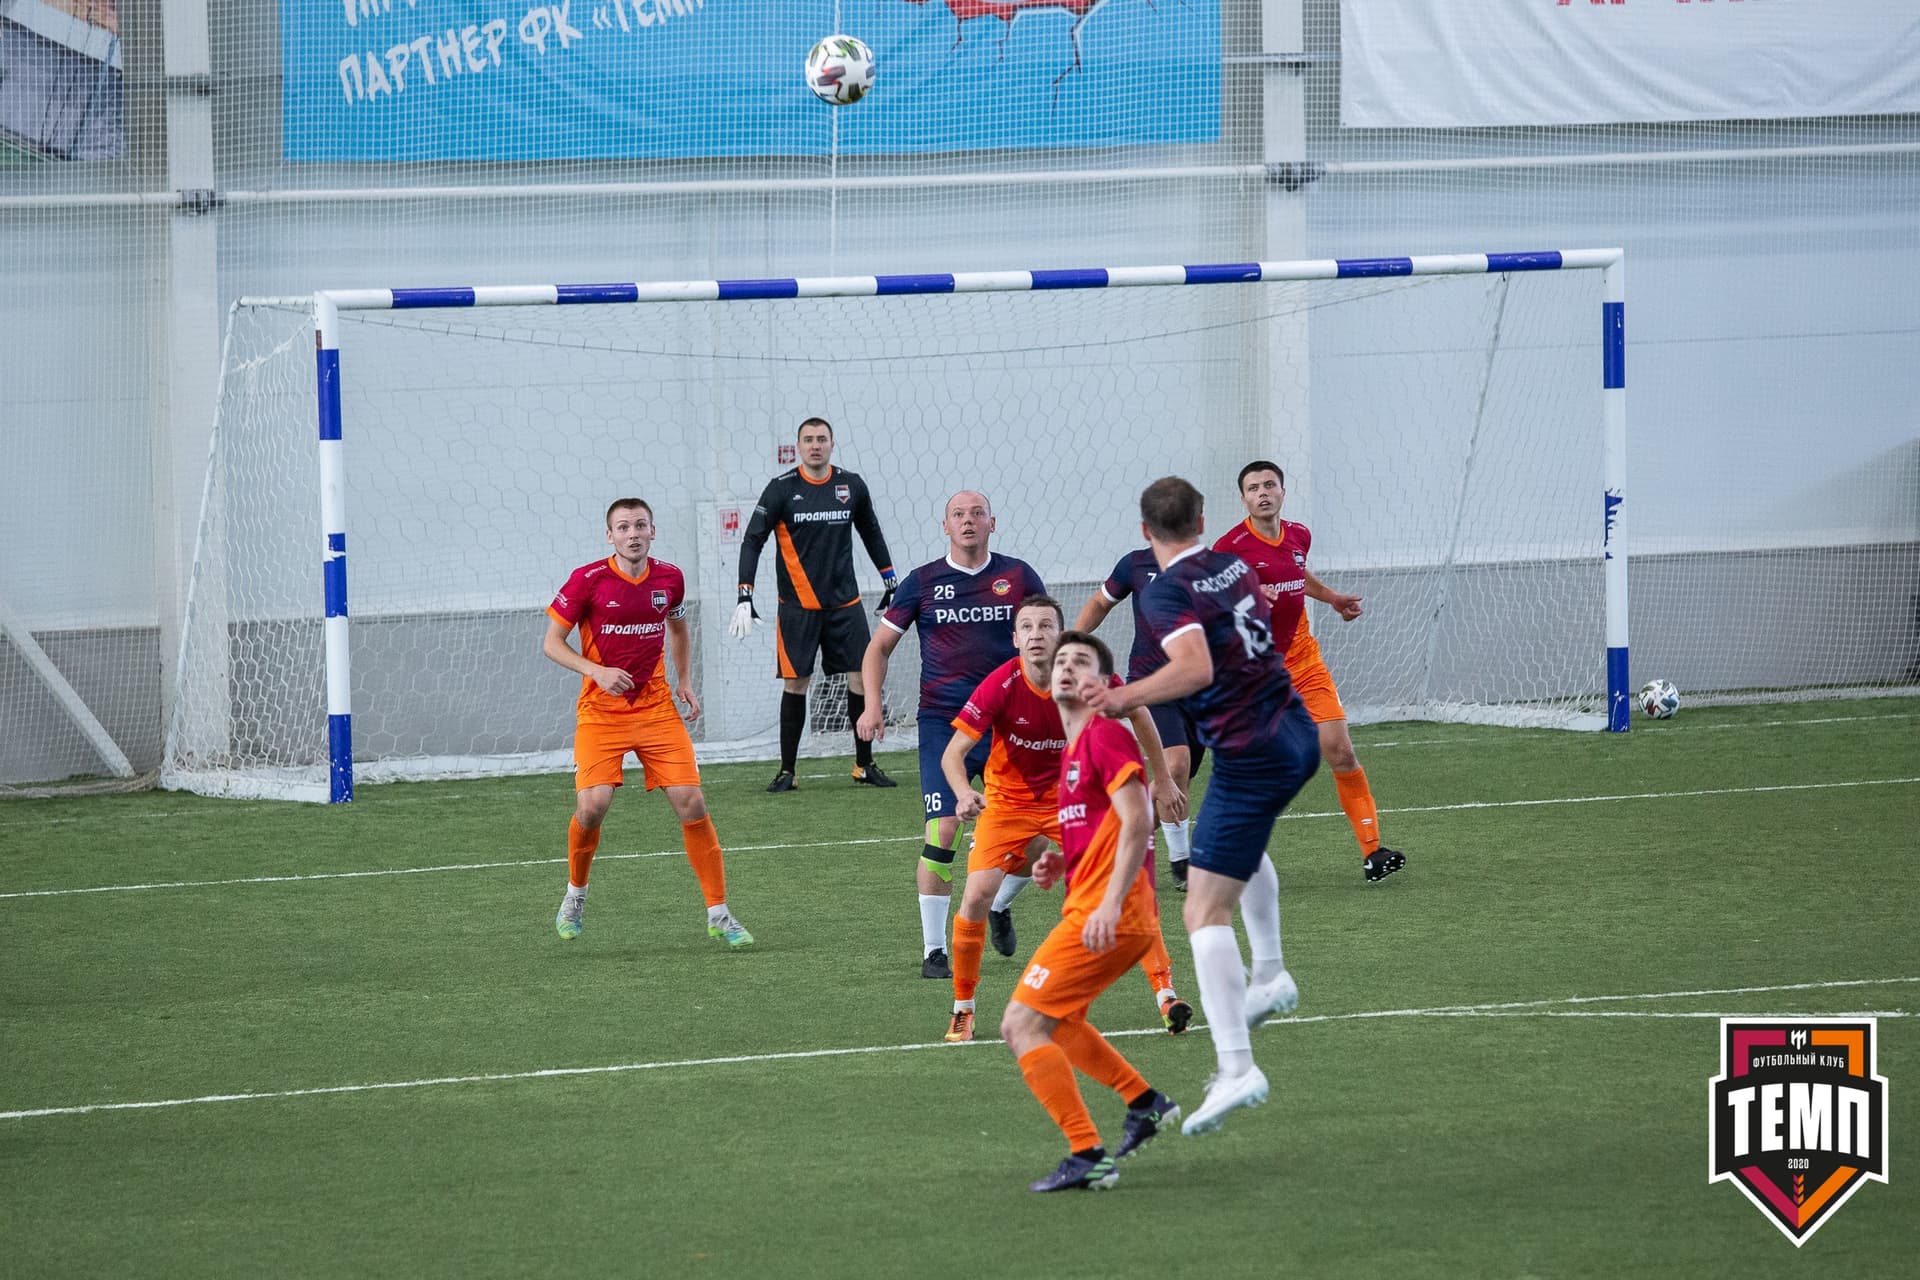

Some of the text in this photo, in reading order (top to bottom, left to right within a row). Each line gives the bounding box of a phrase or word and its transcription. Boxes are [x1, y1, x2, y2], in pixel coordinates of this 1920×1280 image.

[339, 19, 507, 105] ПАРТНЕР
[518, 0, 583, 55] ФК
[794, 509, 852, 524] ПРОДИНВЕСТ
[933, 584, 956, 600] 26
[934, 604, 1014, 624] РАССВЕТ
[924, 792, 942, 813] 26
[1023, 963, 1051, 990] 23
